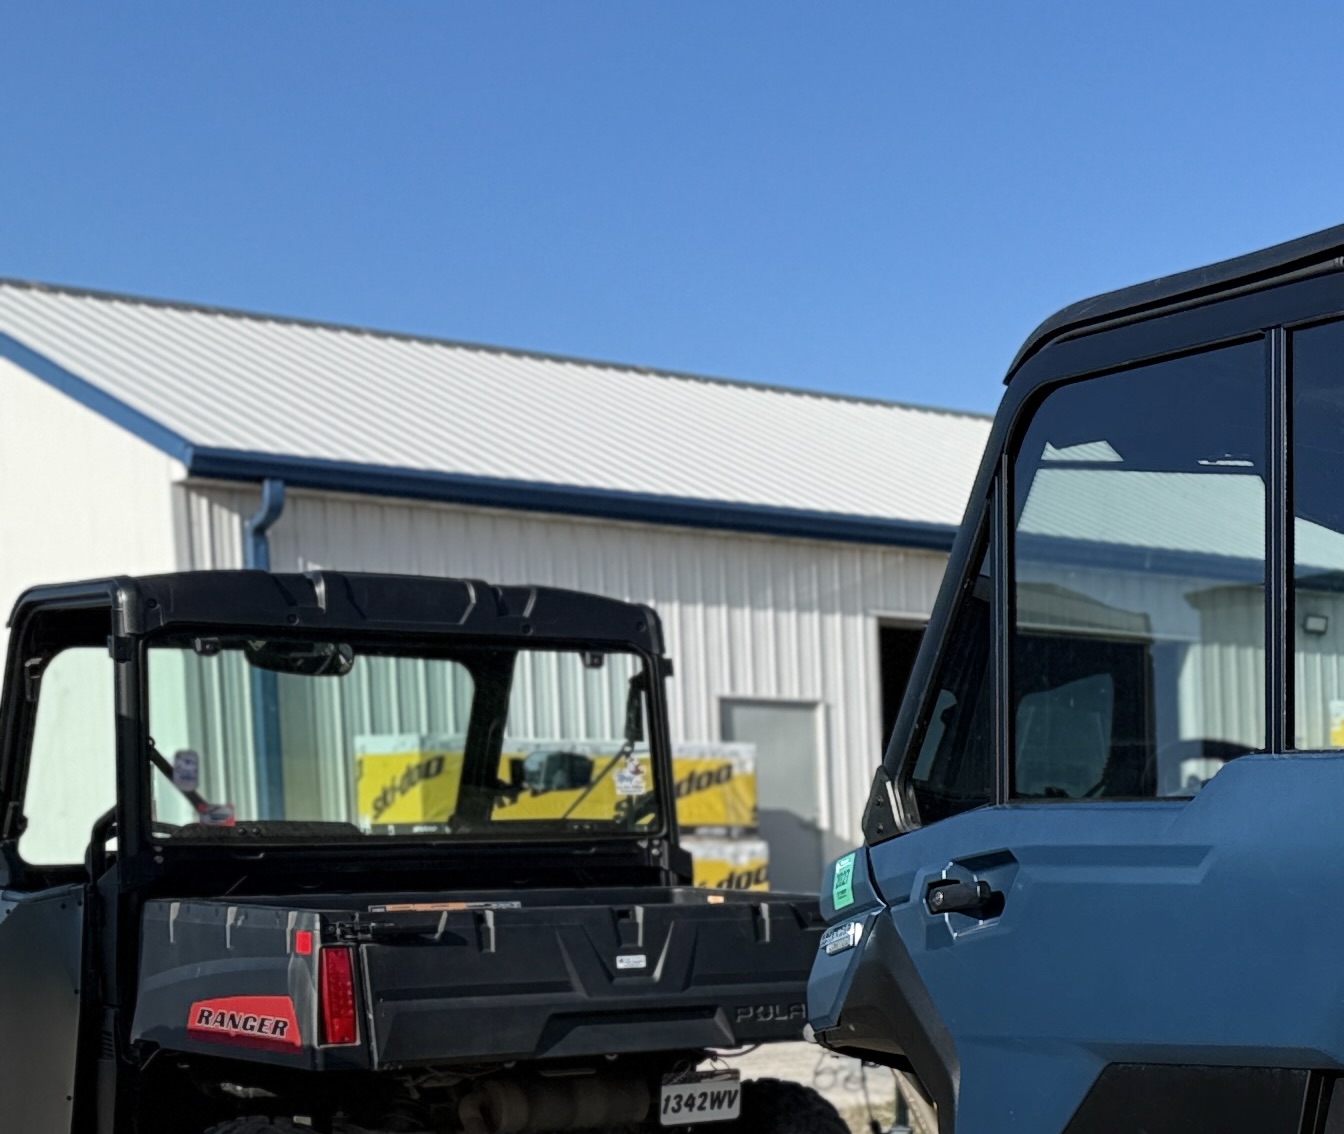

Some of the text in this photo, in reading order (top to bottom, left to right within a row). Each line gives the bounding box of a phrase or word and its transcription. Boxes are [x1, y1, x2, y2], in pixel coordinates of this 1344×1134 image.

[196, 1008, 289, 1037] RANGER
[736, 1003, 806, 1023] POLA
[662, 1089, 739, 1115] 1342WV
